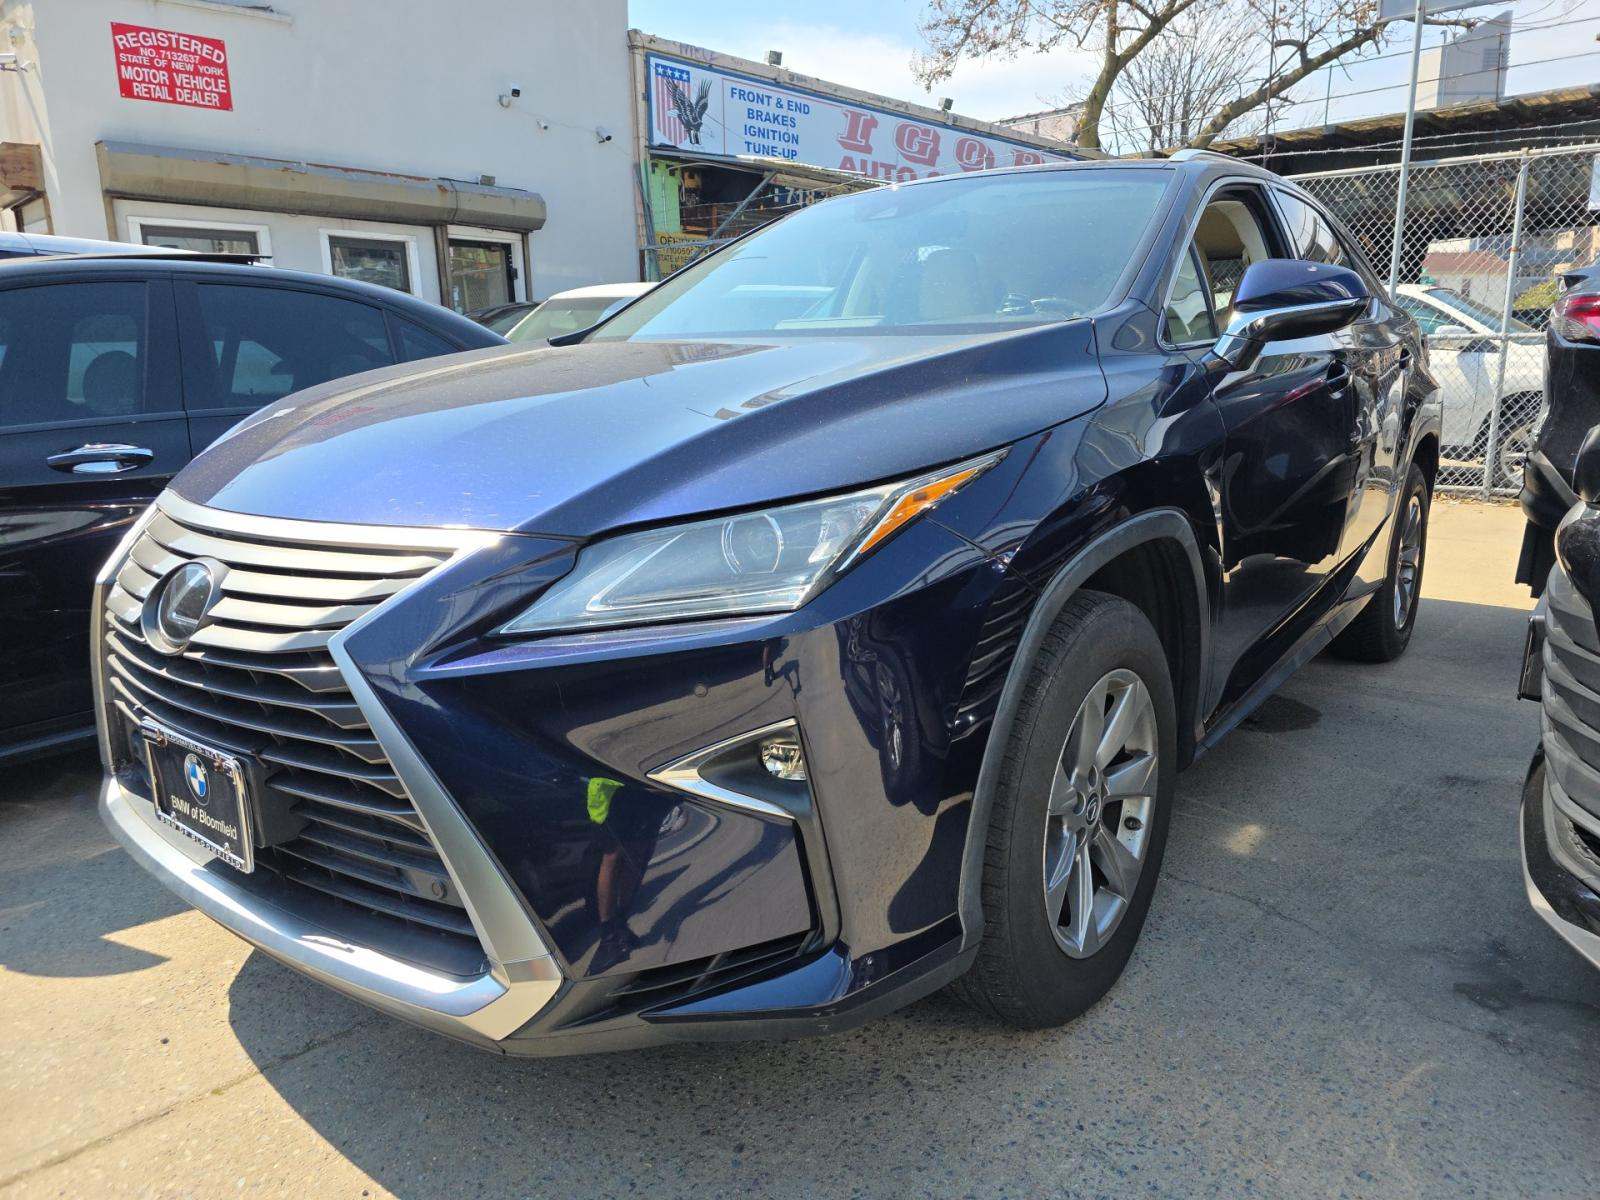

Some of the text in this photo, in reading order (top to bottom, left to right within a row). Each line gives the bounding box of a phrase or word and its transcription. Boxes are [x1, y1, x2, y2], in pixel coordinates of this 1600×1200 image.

[114, 31, 225, 63] REGISTERED
[140, 47, 159, 58] NO.
[120, 53, 224, 76] STATE OF NEW YORK
[120, 65, 227, 93] MOTOR VEHICLE
[133, 82, 220, 106] RETAIL DEALER
[730, 87, 810, 115] FRONT & END
[747, 108, 796, 128] BRAKES
[744, 124, 799, 145] IGNITION
[744, 141, 798, 160] TUNE-UP
[839, 155, 918, 184] AUTO
[170, 795, 238, 840] BMW of Bloomfield
